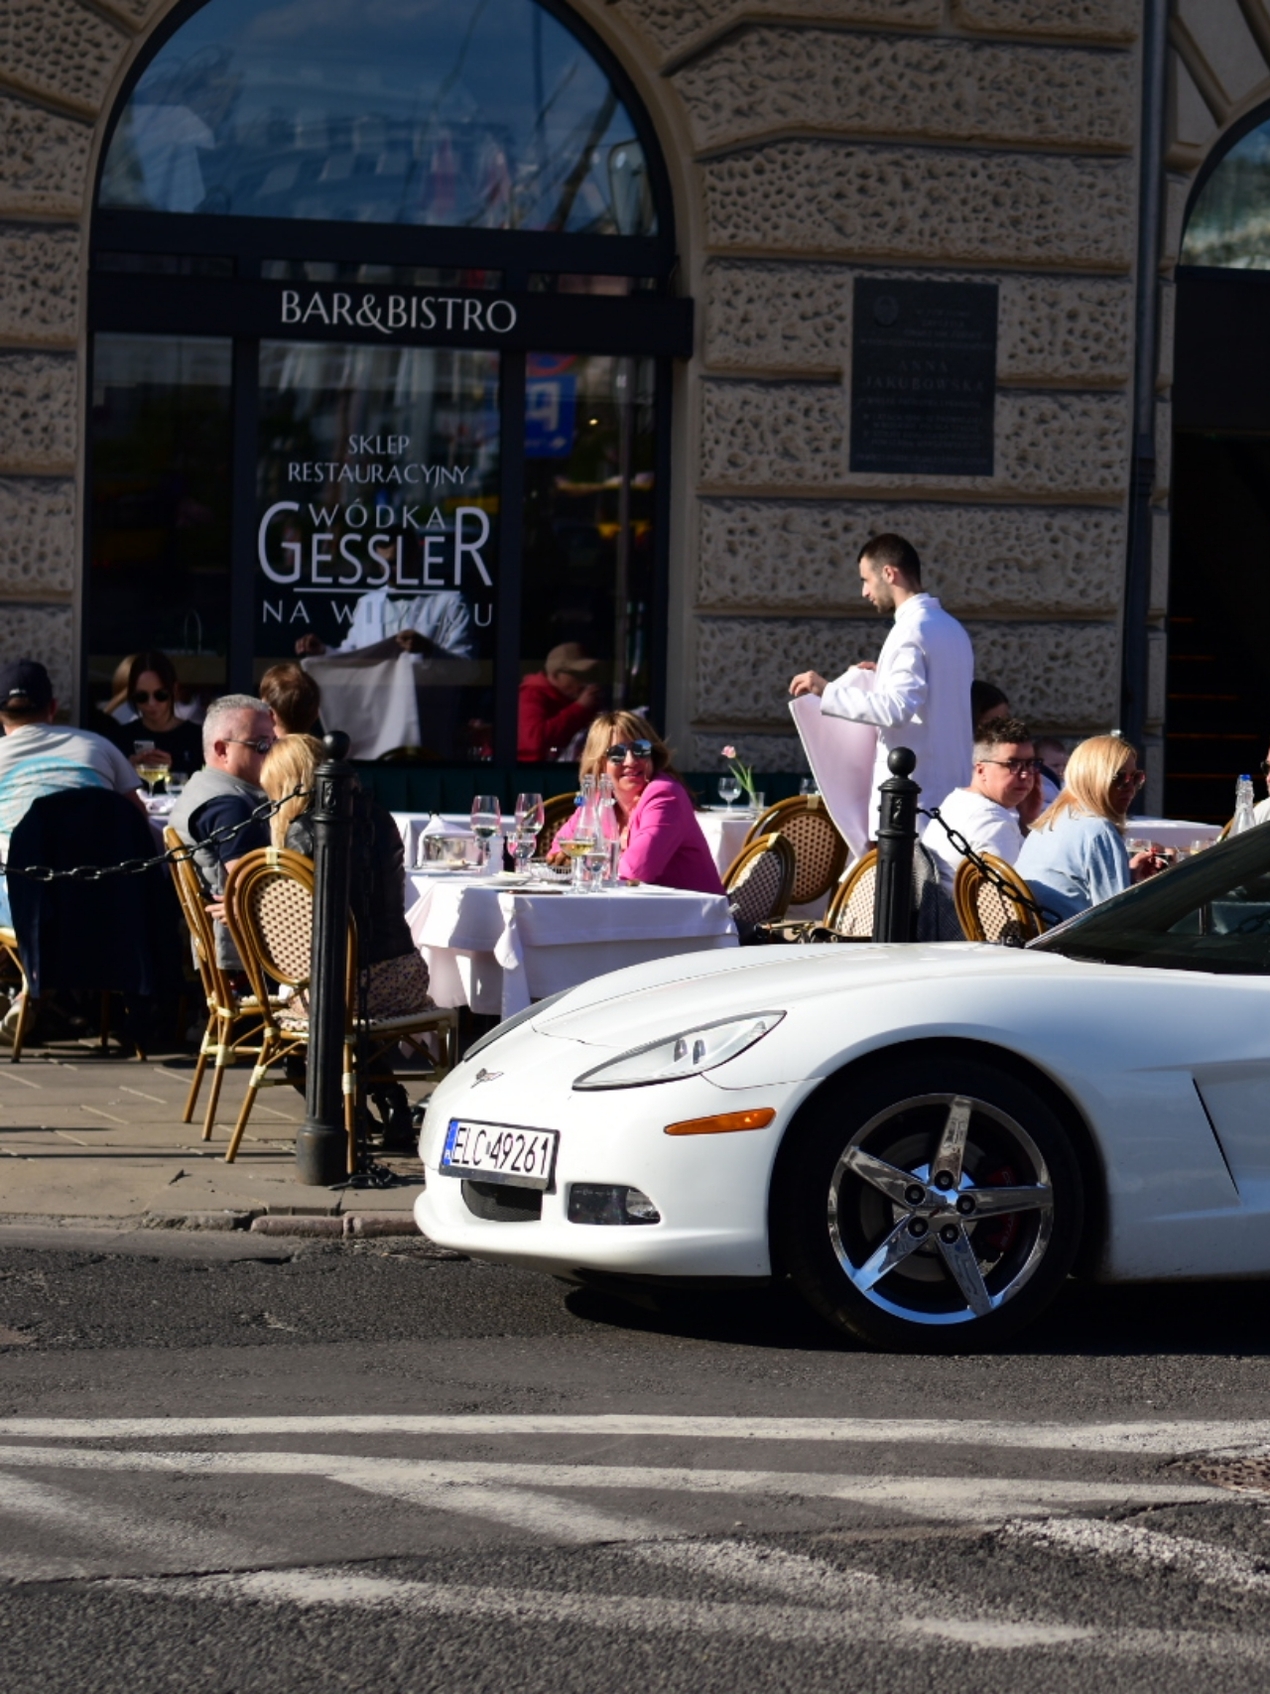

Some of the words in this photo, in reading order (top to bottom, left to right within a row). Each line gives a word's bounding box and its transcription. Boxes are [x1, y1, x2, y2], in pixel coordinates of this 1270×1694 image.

[280, 289, 517, 335] BAR&BISTRO
[347, 434, 410, 455] SKLEP
[288, 462, 469, 488] RESTAURACYJNY
[308, 498, 446, 529] WÓDKA
[258, 500, 493, 586] GESSLER
[262, 599, 310, 624] NA
[452, 1127, 487, 1166] ELC
[489, 1131, 549, 1175] 49261
